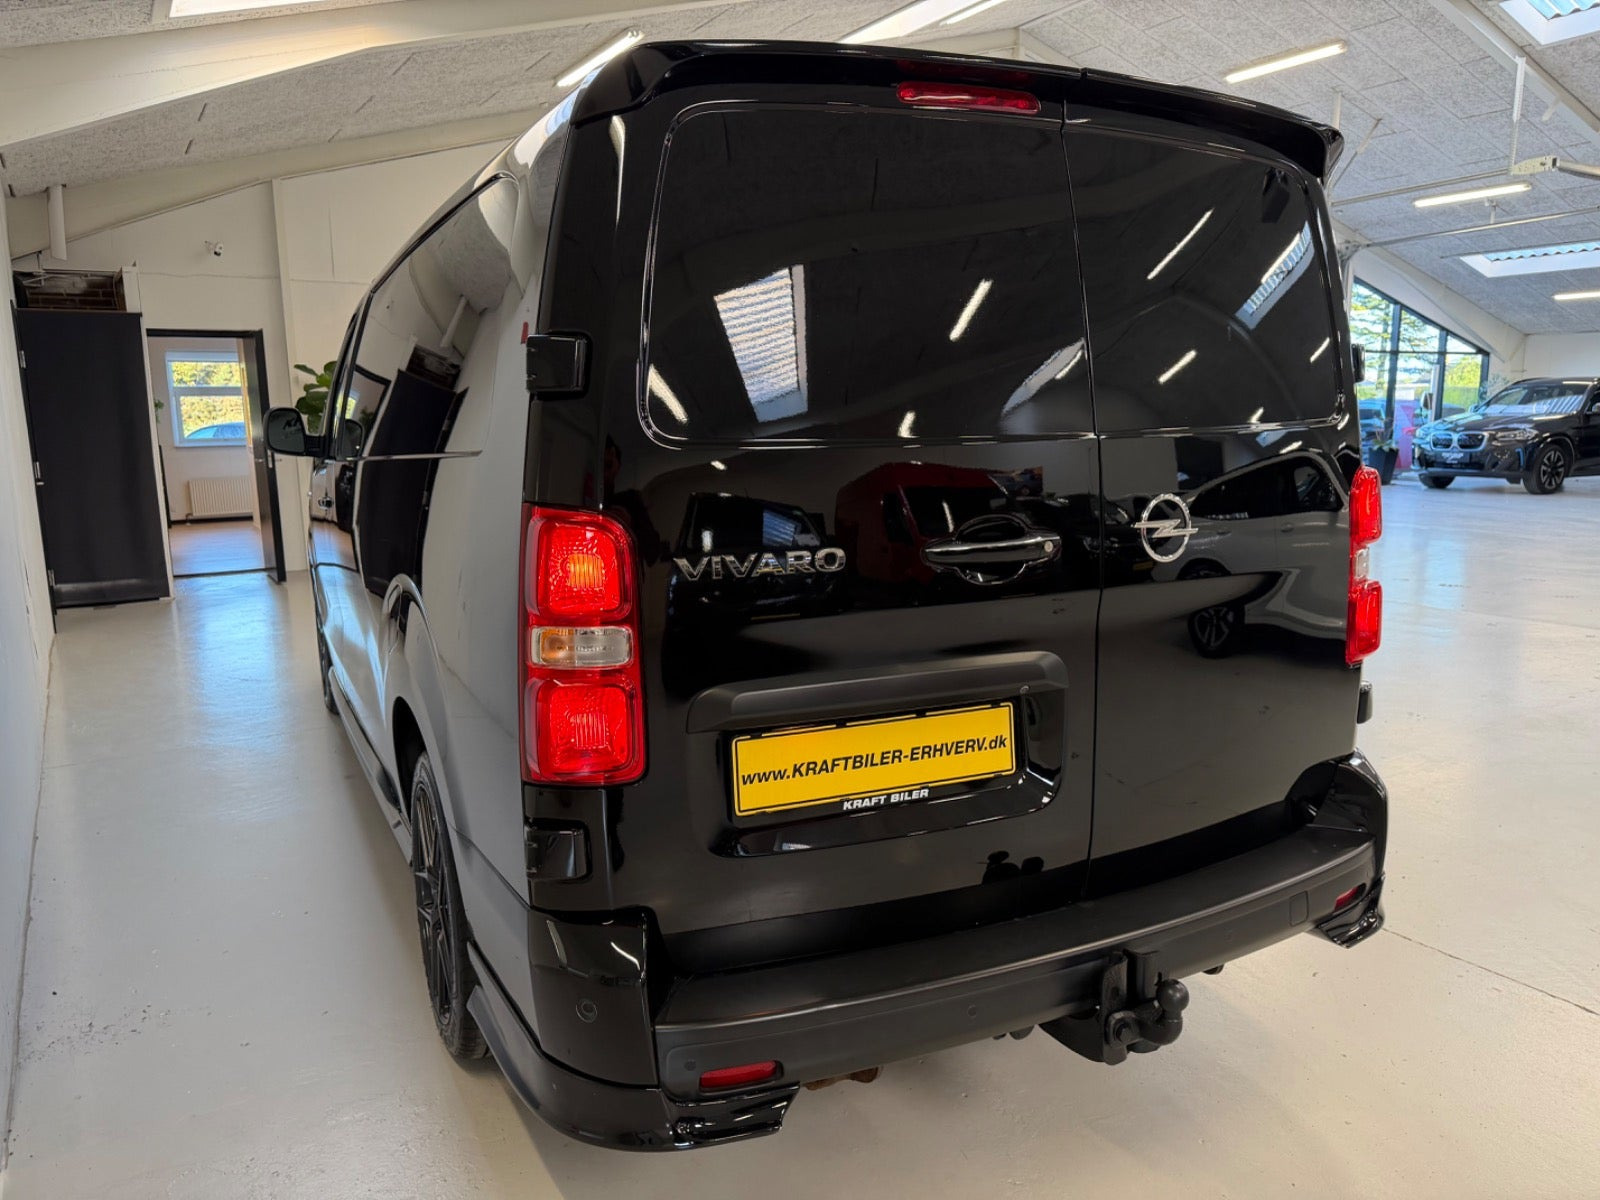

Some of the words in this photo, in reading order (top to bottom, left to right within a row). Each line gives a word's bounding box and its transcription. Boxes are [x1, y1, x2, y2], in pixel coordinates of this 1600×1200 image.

[673, 548, 846, 581] VIVARO
[741, 735, 1007, 786] www.KRAFTBILER-ERHVERV.dk
[843, 795, 887, 810] KRAFT
[890, 788, 929, 803] BILER
